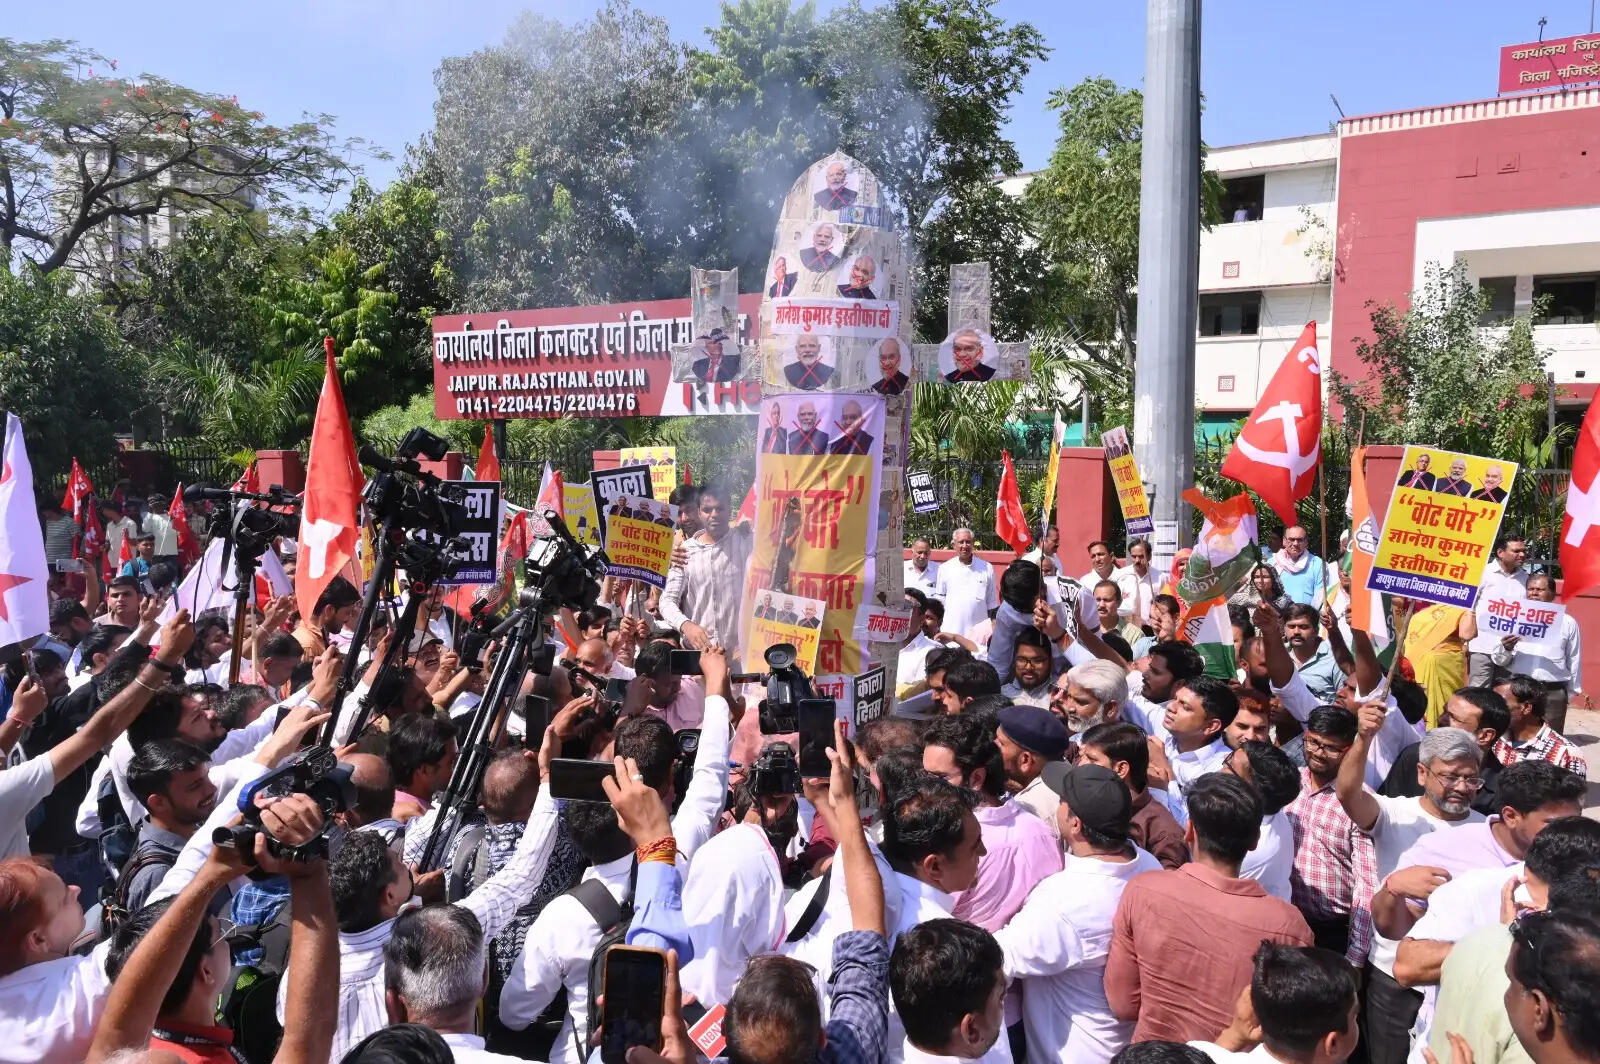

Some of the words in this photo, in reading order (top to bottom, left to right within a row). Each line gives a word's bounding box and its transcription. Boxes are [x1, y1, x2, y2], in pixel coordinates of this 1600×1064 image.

[1520, 70, 1551, 84] जिला
[802, 306, 833, 332] कुमार
[836, 302, 878, 328] इस्तीफा
[879, 304, 890, 328] दो
[435, 320, 494, 364] कार्यालय
[498, 320, 536, 362] जिला
[538, 324, 600, 359] कलक्टर
[603, 313, 627, 355] एवं
[630, 310, 671, 353] जिला
[447, 368, 646, 392] JAIPUR.RAJASTHAN.GOV.IN
[456, 393, 636, 414] 0141-2204475/2204476
[597, 471, 646, 499] काला
[910, 474, 930, 488] काला
[1398, 493, 1446, 527] “वोट
[1446, 503, 1496, 534] चोर”
[612, 520, 641, 540] “वोट
[644, 526, 670, 545] चोर”
[1388, 528, 1438, 549] ज्ञानेश
[1439, 538, 1485, 560] कुमार
[642, 545, 667, 560] कुमार
[1389, 553, 1446, 574] इस्तीफा
[1449, 562, 1469, 580] दो
[1376, 573, 1396, 589] जयपुर
[1396, 577, 1411, 588] शहर
[1410, 577, 1428, 592] जिला
[1488, 599, 1558, 624] मोदी-शाह
[1488, 614, 1518, 634] शर्म
[1518, 618, 1548, 638] करो
[820, 628, 844, 674] दो
[858, 671, 884, 698] काला
[856, 698, 883, 726] दिवस
